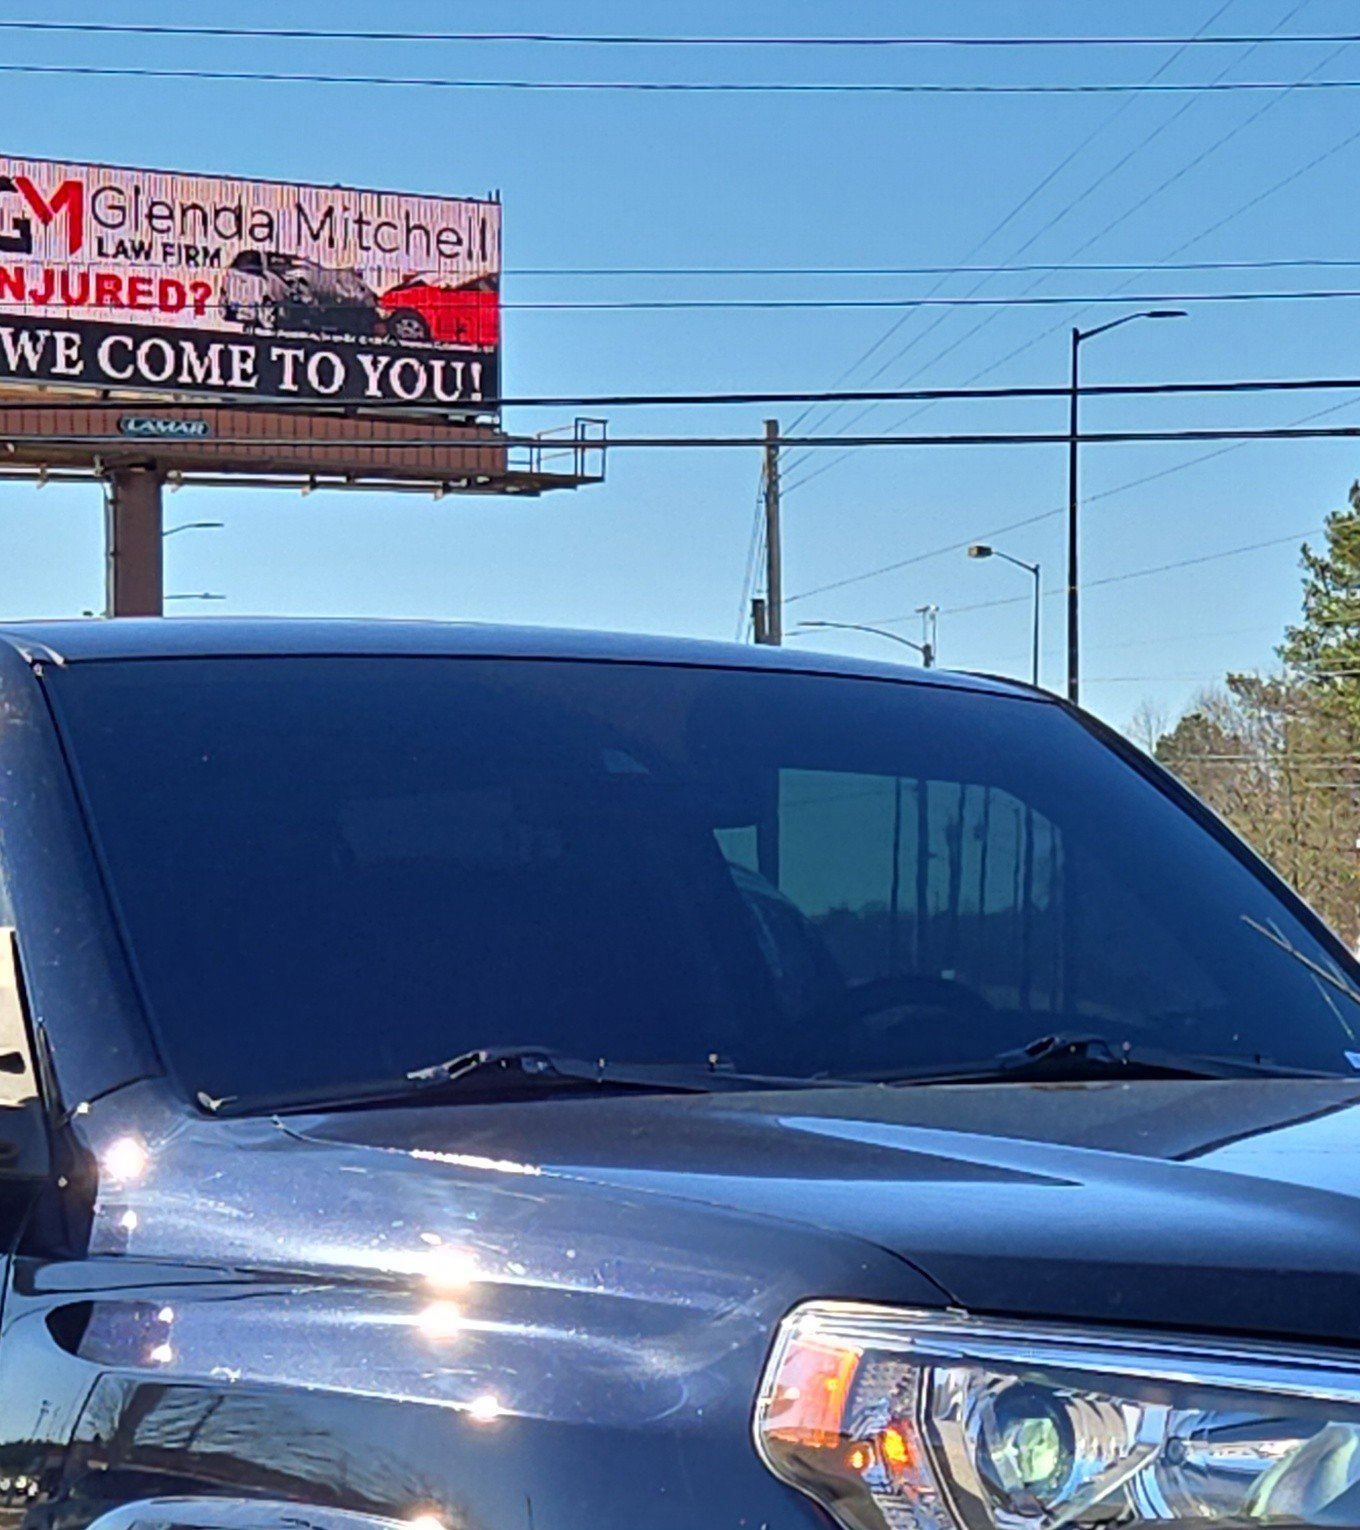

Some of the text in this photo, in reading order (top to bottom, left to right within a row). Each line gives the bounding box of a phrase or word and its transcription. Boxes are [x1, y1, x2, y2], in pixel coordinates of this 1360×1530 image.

[91, 184, 488, 263] Glenda Mitchell
[97, 236, 222, 268] LAW FIRM
[97, 334, 259, 389] COME
[271, 346, 345, 394] TO
[356, 353, 482, 402] YOU!
[127, 418, 206, 435] LAMAR
